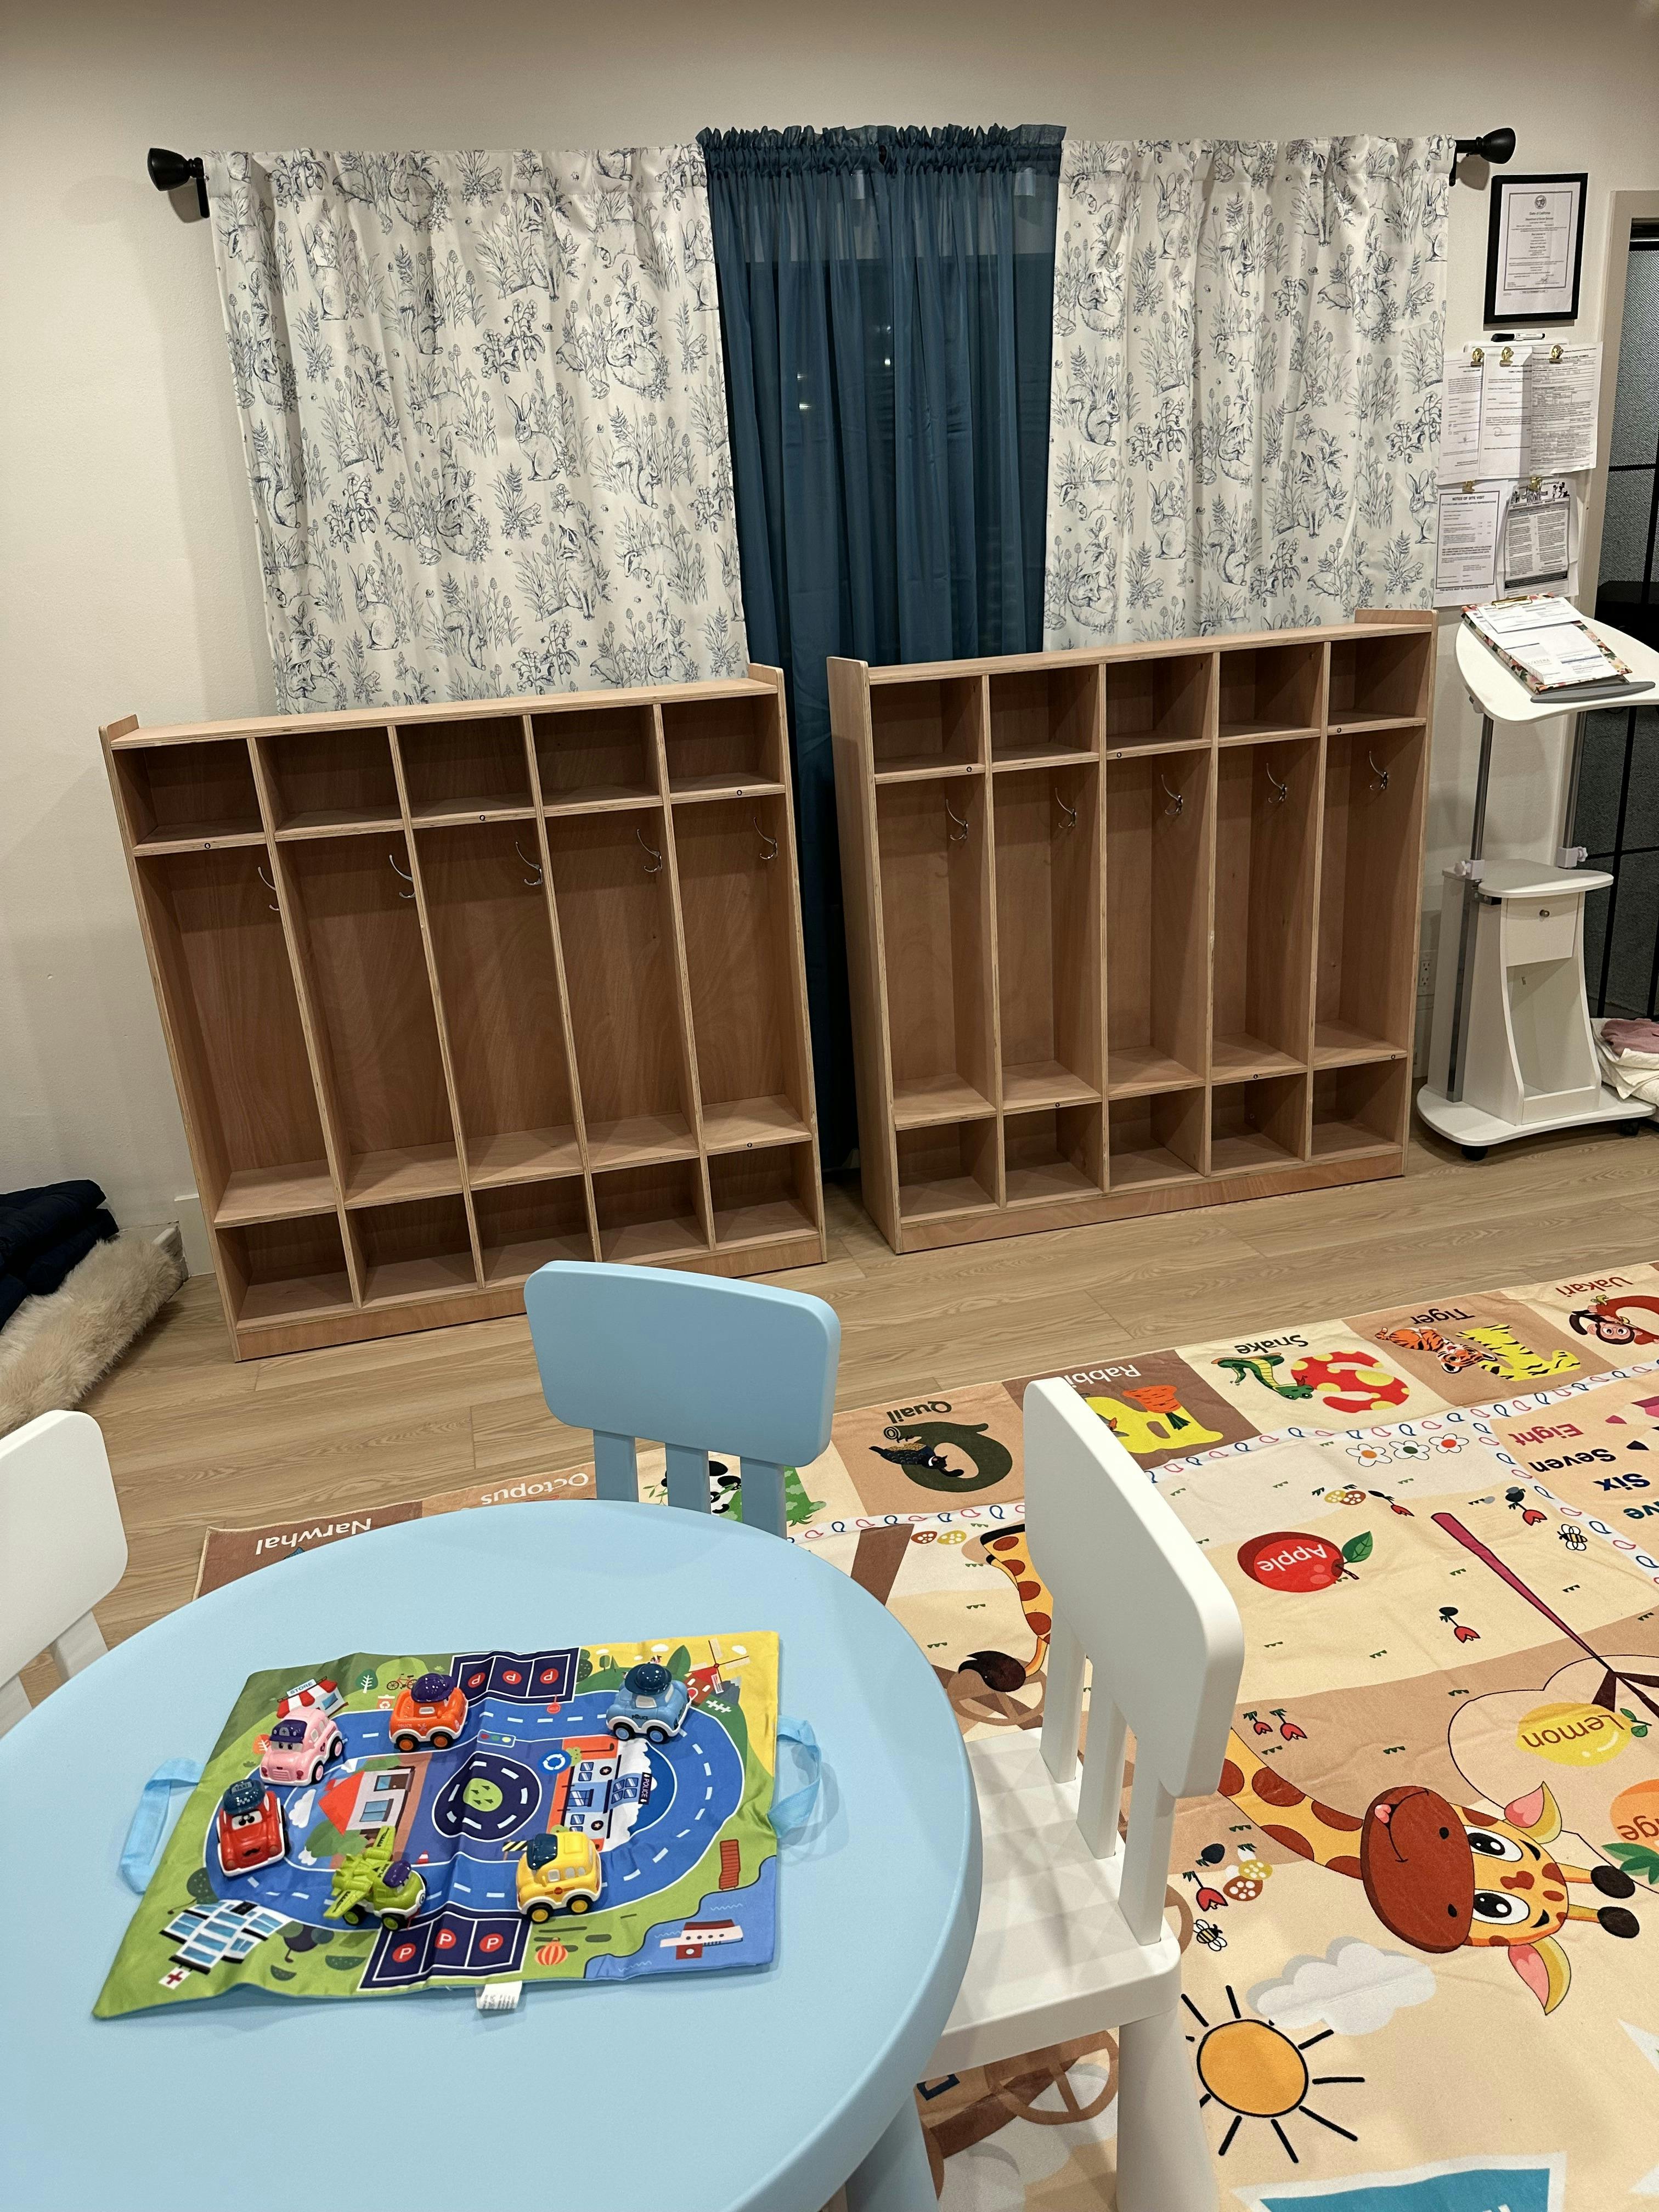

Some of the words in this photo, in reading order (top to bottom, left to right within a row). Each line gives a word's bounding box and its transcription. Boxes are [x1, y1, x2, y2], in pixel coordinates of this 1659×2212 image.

[1555, 1277, 1634, 1297] Uakari
[1410, 1308, 1475, 1324] Tiger
[1234, 1335, 1308, 1353] Snake
[1069, 1364, 1141, 1388] Rabbi
[886, 1401, 952, 1424] Quail
[1506, 1424, 1584, 1446] Eight
[1529, 1448, 1616, 1472] Seven
[482, 1473, 589, 1504] Octopus
[1593, 1473, 1650, 1491] Six
[255, 1518, 371, 1555] Narwhal
[1257, 1543, 1327, 1572] Apple
[290, 1681, 313, 1694] STORE
[471, 1674, 482, 1685] P
[506, 1673, 516, 1681] P
[543, 1671, 554, 1681] P
[1522, 1714, 1625, 1747] Lemon
[641, 1778, 650, 1798] POLICE
[399, 1947, 411, 1959] P
[439, 1933, 452, 1945] P
[487, 1938, 499, 1949] P
